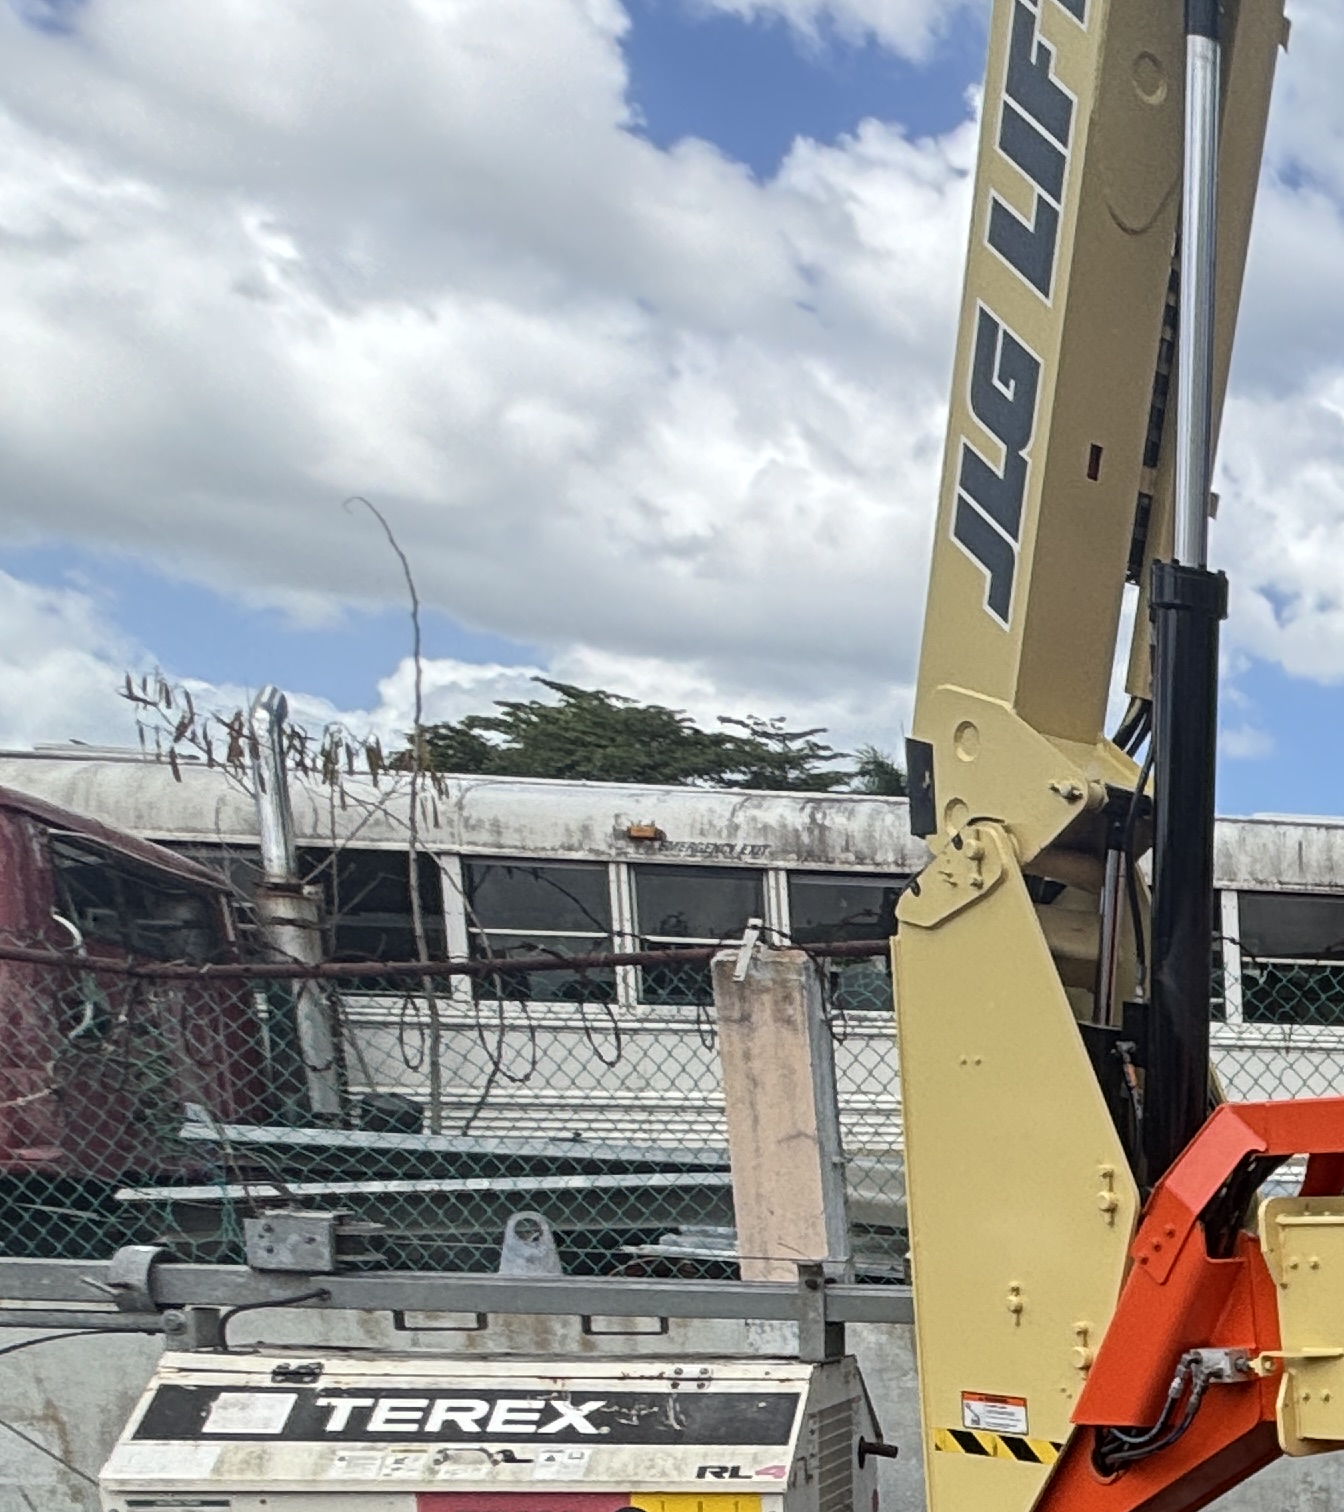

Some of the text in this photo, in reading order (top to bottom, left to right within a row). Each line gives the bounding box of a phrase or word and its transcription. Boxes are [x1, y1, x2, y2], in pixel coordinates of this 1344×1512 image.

[949, 0, 1092, 633] JLG LIF
[316, 1397, 608, 1435] TEREX
[695, 1464, 787, 1480] RL4
